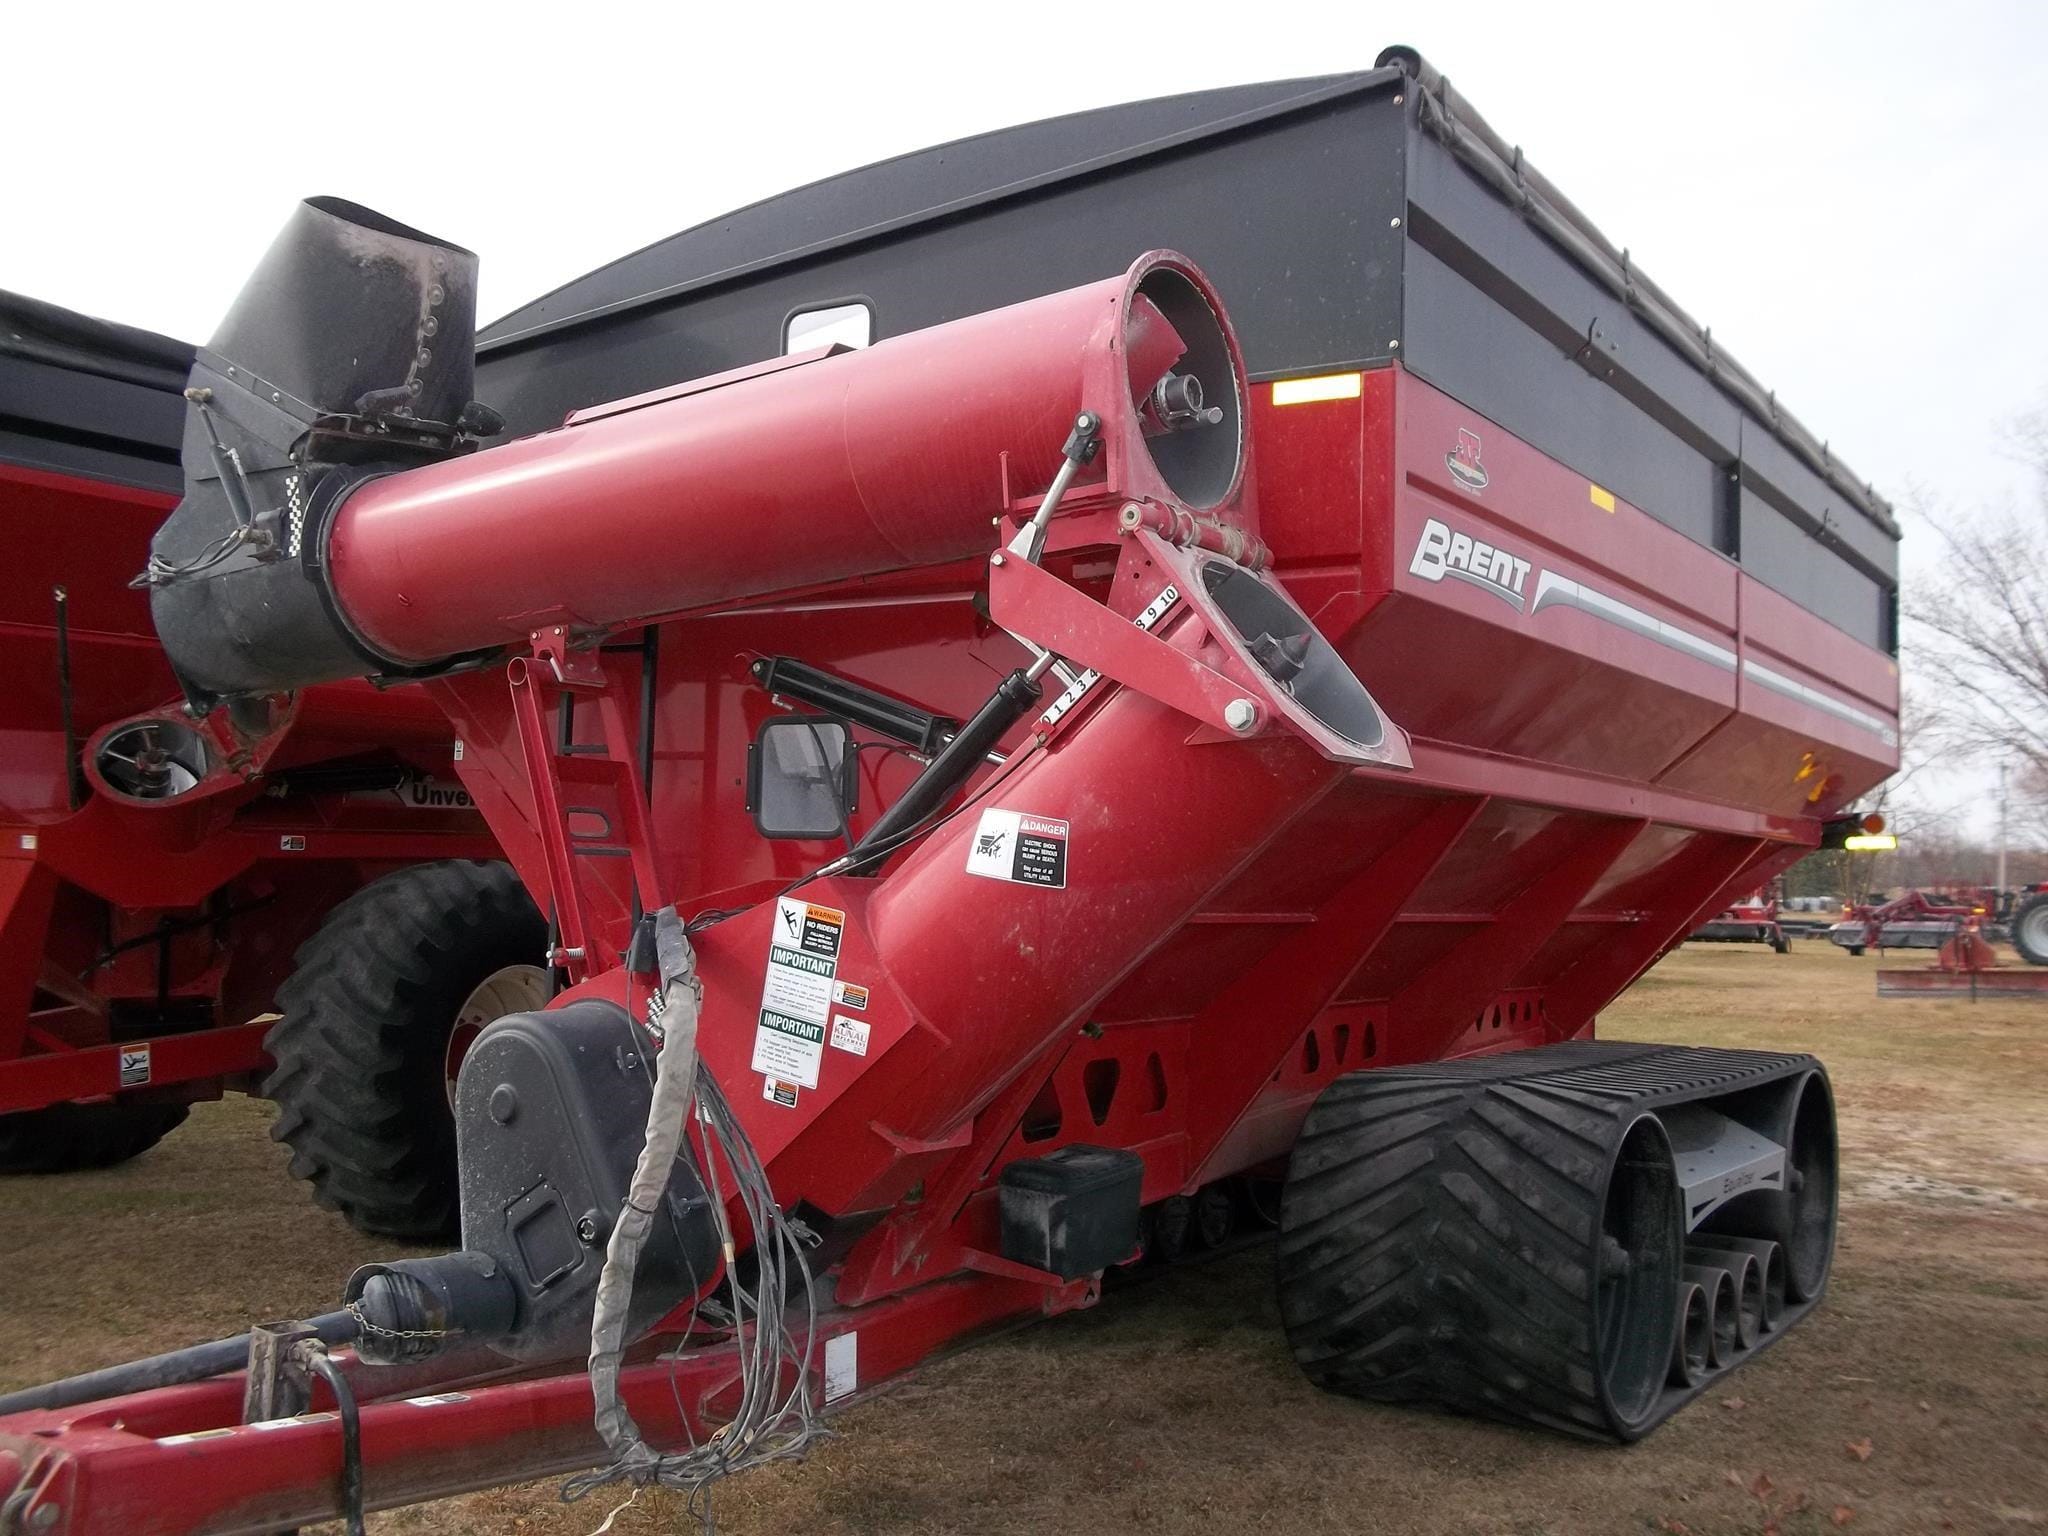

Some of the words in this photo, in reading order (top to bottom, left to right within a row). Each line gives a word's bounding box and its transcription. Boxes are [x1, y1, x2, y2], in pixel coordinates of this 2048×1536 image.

[1054, 704, 1064, 715] 1
[1065, 692, 1076, 703] 2
[1076, 680, 1087, 692] 3
[1090, 668, 1098, 678] 4
[1136, 619, 1146, 630] 8
[1148, 607, 1157, 619] 9
[1160, 588, 1176, 606] 10
[1030, 821, 1065, 834] DANGER
[814, 910, 842, 921] WARNING
[816, 923, 838, 934] RIDERS
[773, 948, 832, 974] IMPORTANT
[764, 1012, 819, 1038] IMPORTANT
